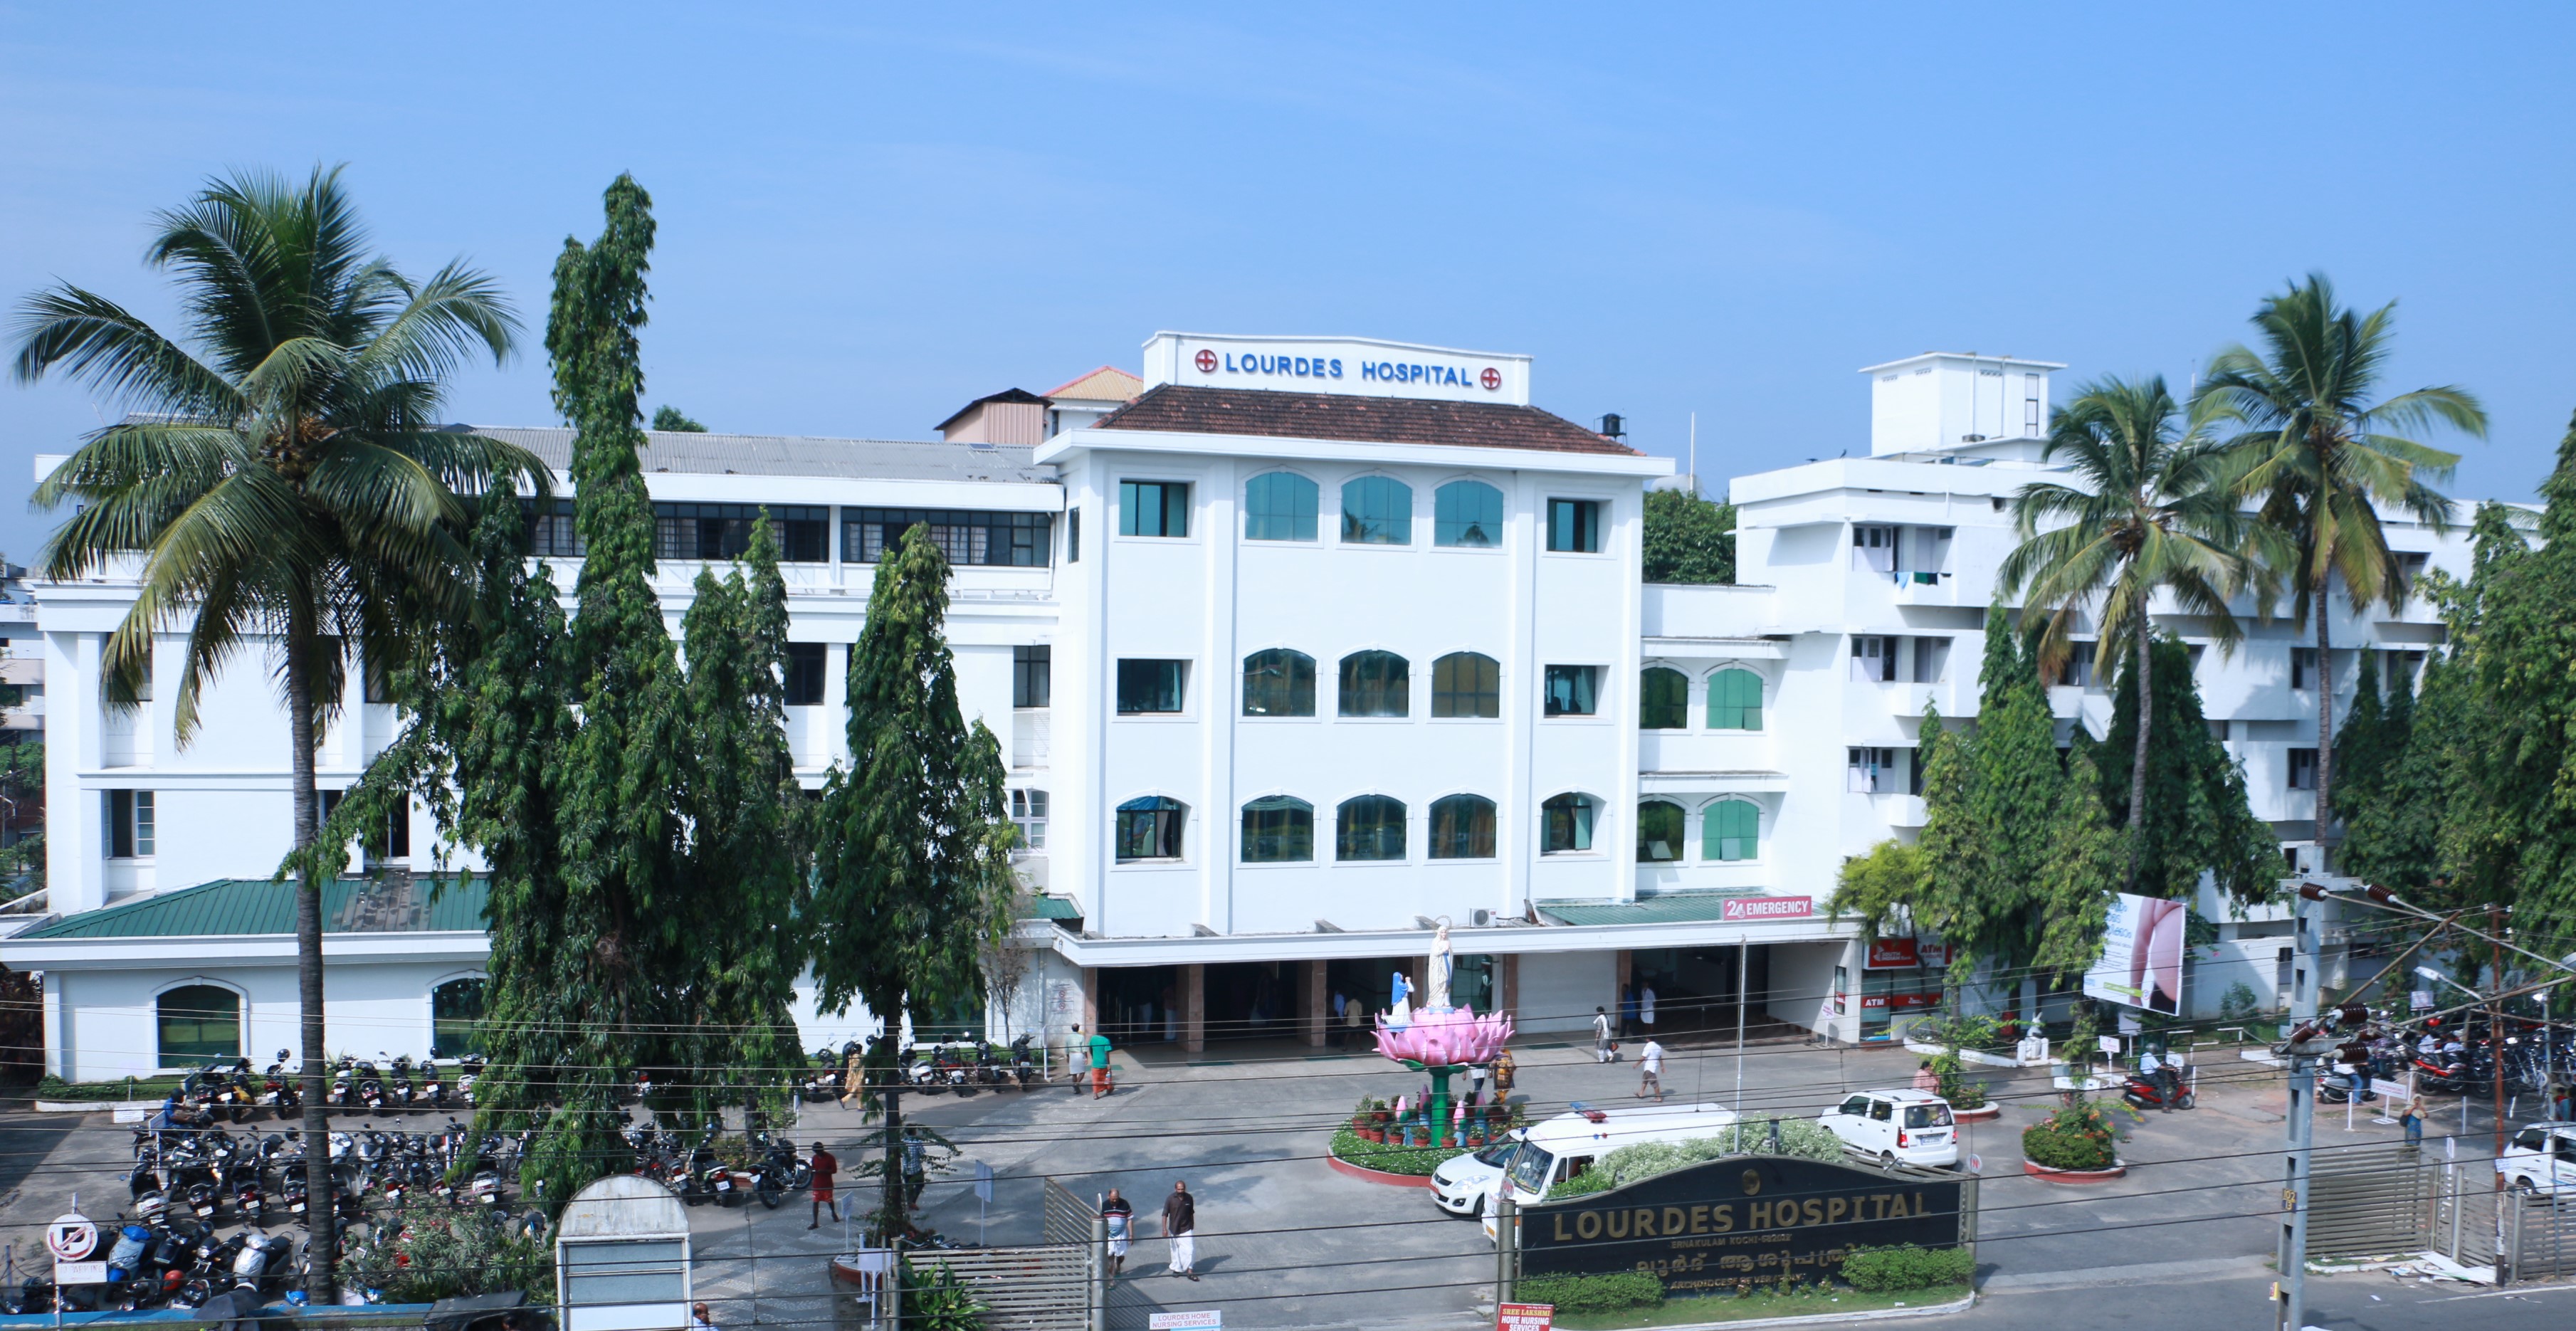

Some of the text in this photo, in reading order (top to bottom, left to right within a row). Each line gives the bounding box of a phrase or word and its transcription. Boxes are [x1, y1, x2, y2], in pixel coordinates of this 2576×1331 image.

[1226, 352, 1473, 386] LOURDES HOSPITAL
[1727, 900, 1809, 918] 24 EMERGENCY
[1920, 945, 1942, 953] ATM
[1865, 998, 1884, 1006] ATM
[1555, 1192, 1931, 1241] LOURDES HOSPITAL
[1671, 1237, 1726, 1248] ERNAKULAM
[1521, 1316, 1550, 1325] NURSING
